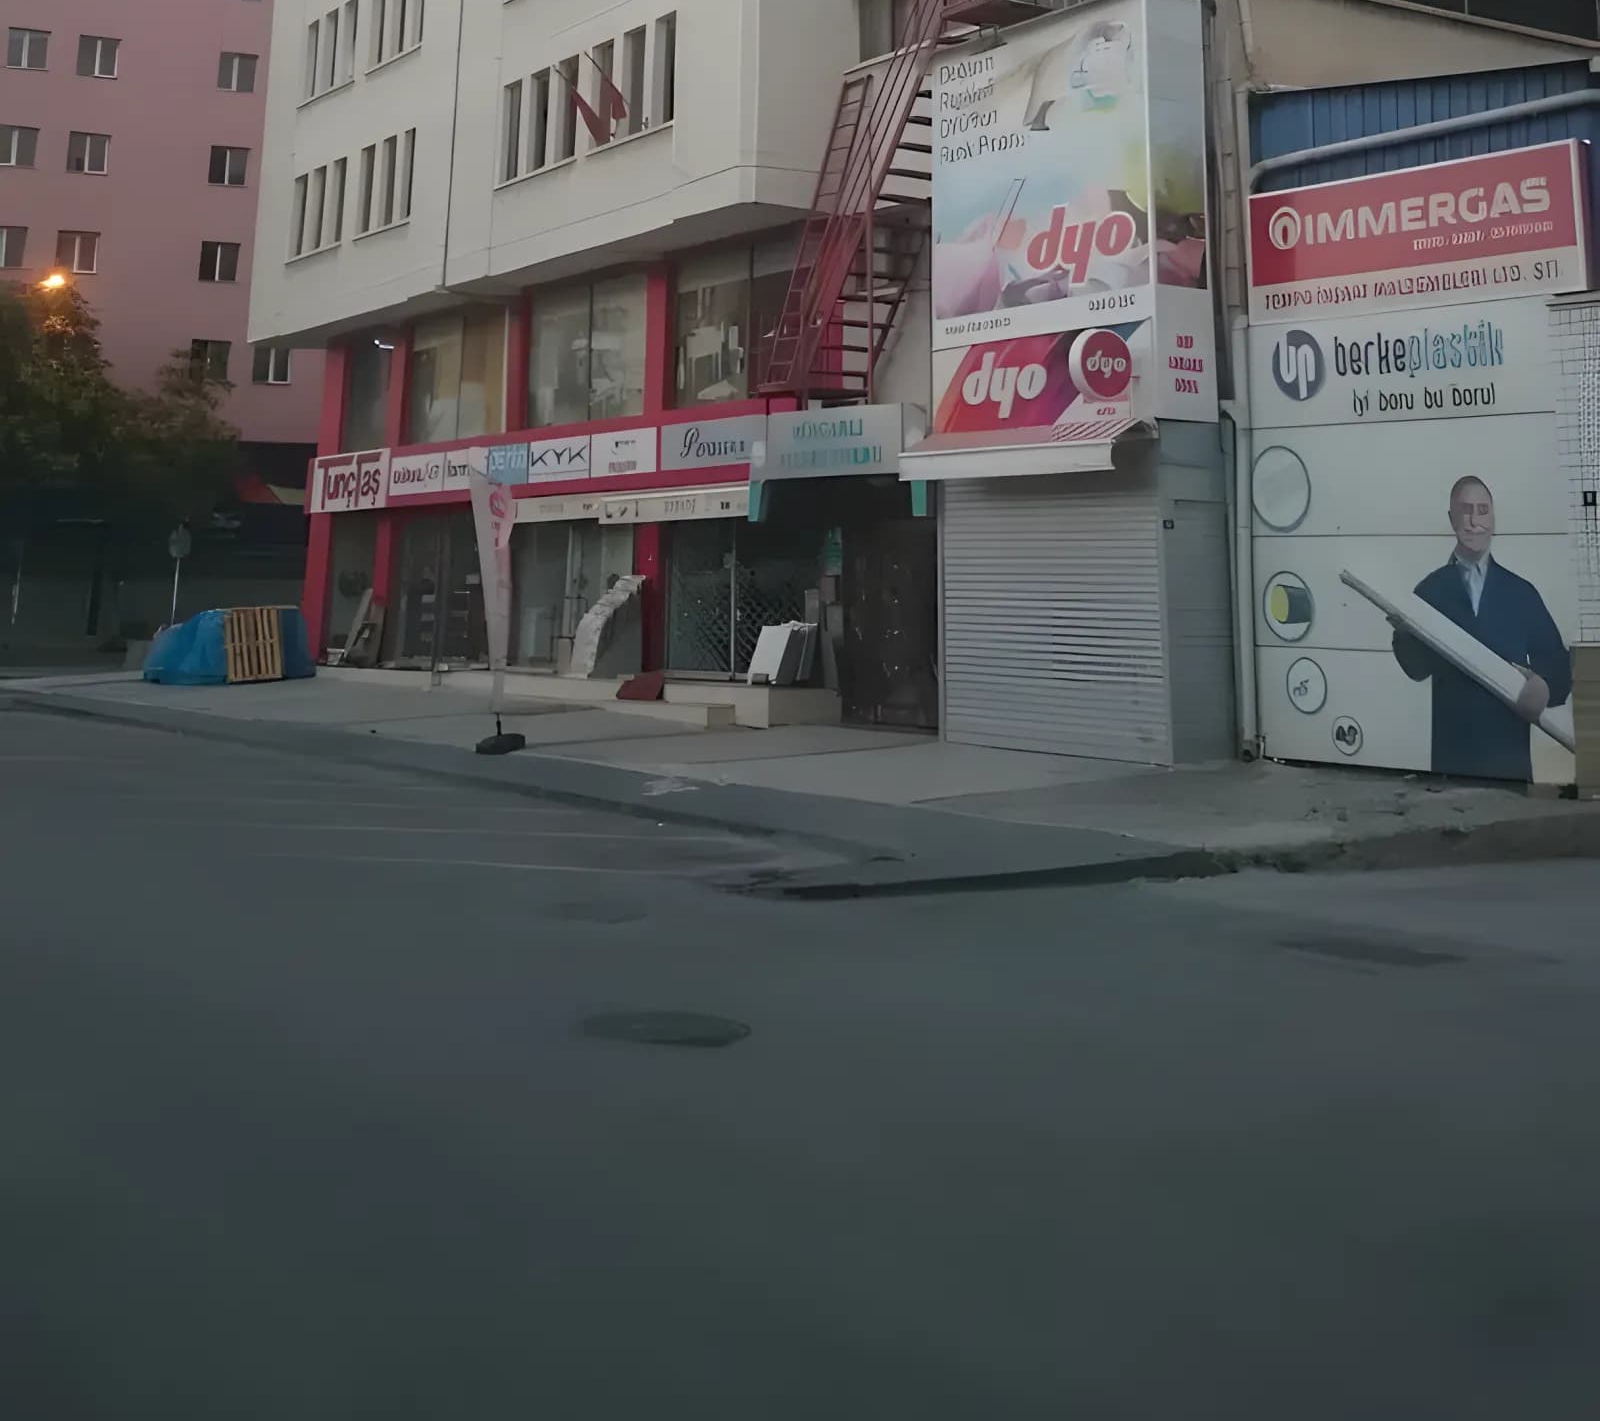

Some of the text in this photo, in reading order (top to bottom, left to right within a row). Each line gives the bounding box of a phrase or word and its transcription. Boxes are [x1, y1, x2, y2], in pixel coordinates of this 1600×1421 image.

[1026, 205, 1135, 285] dyo
[1304, 177, 1551, 245] IMMERGAS
[961, 351, 1048, 419] dyo
[531, 444, 589, 468] KYK
